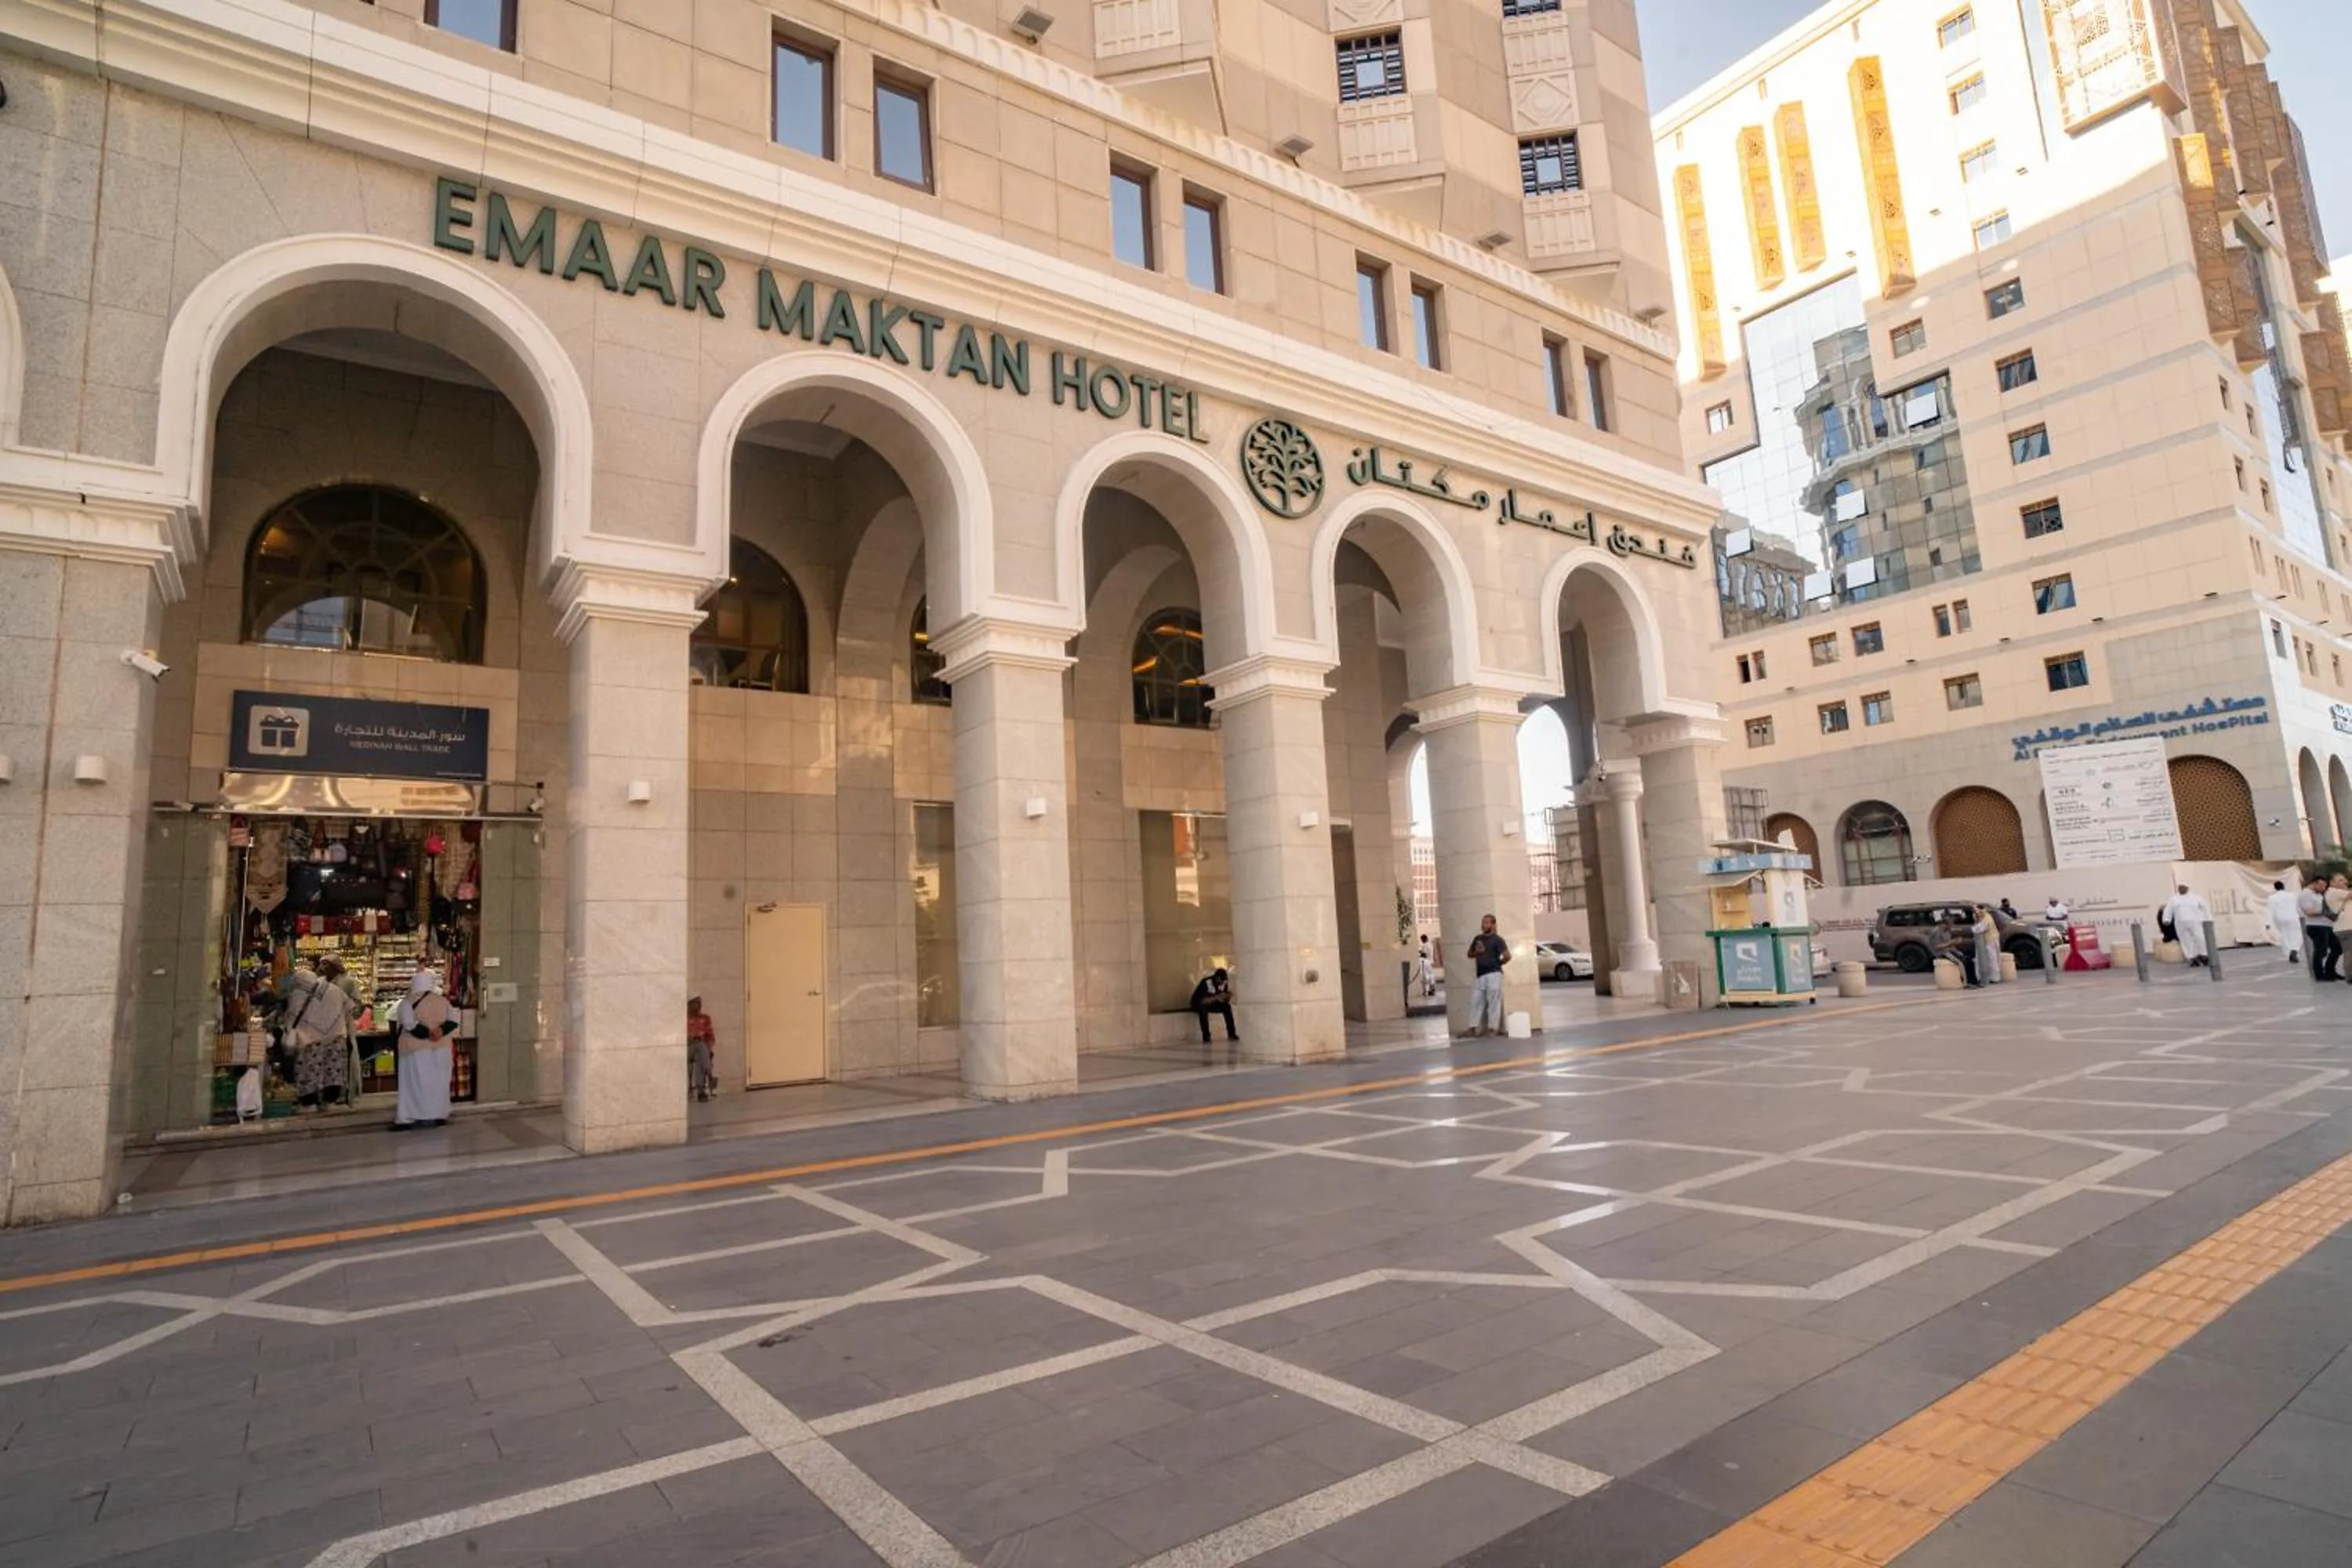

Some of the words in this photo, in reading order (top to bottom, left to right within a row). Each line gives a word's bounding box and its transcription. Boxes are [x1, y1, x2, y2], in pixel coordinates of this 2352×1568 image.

[434, 176, 724, 318] EMAAR
[757, 268, 1029, 395] MAKTAN
[1051, 350, 1210, 444] HOTEL
[1346, 448, 1490, 511] مكتان
[1607, 524, 1697, 569] فندق
